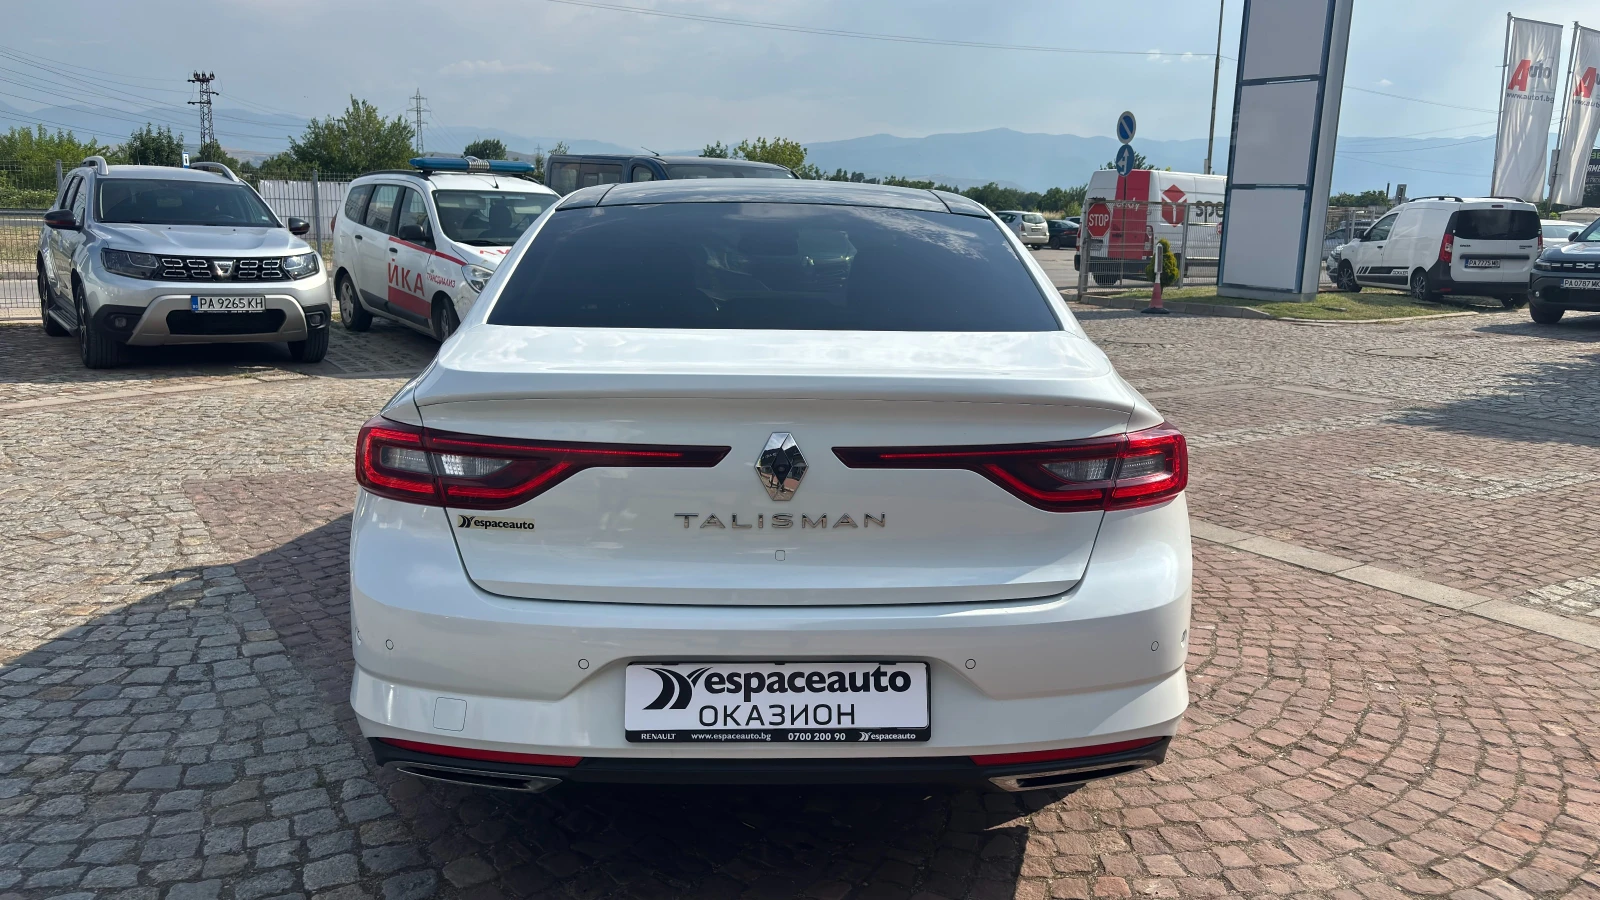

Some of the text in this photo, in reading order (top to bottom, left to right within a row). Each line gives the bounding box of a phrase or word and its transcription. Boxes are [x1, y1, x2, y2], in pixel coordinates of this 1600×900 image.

[1506, 93, 1555, 103] www.auto1.bg
[1089, 214, 1109, 226] STOP
[388, 258, 425, 297] ЙКА
[200, 298, 215, 308] PA
[218, 298, 246, 309] 9265
[248, 298, 263, 309] KH
[474, 520, 535, 530] espaceauto
[674, 512, 887, 529] TALISMAN
[704, 665, 912, 702] espaceauto
[698, 703, 856, 727] ОКАЗИОН
[691, 732, 772, 741] www.espaceauto.bg
[788, 732, 811, 741] 0700
[813, 732, 831, 741] 200
[834, 732, 846, 741] 90
[870, 732, 917, 741] espaceauto
